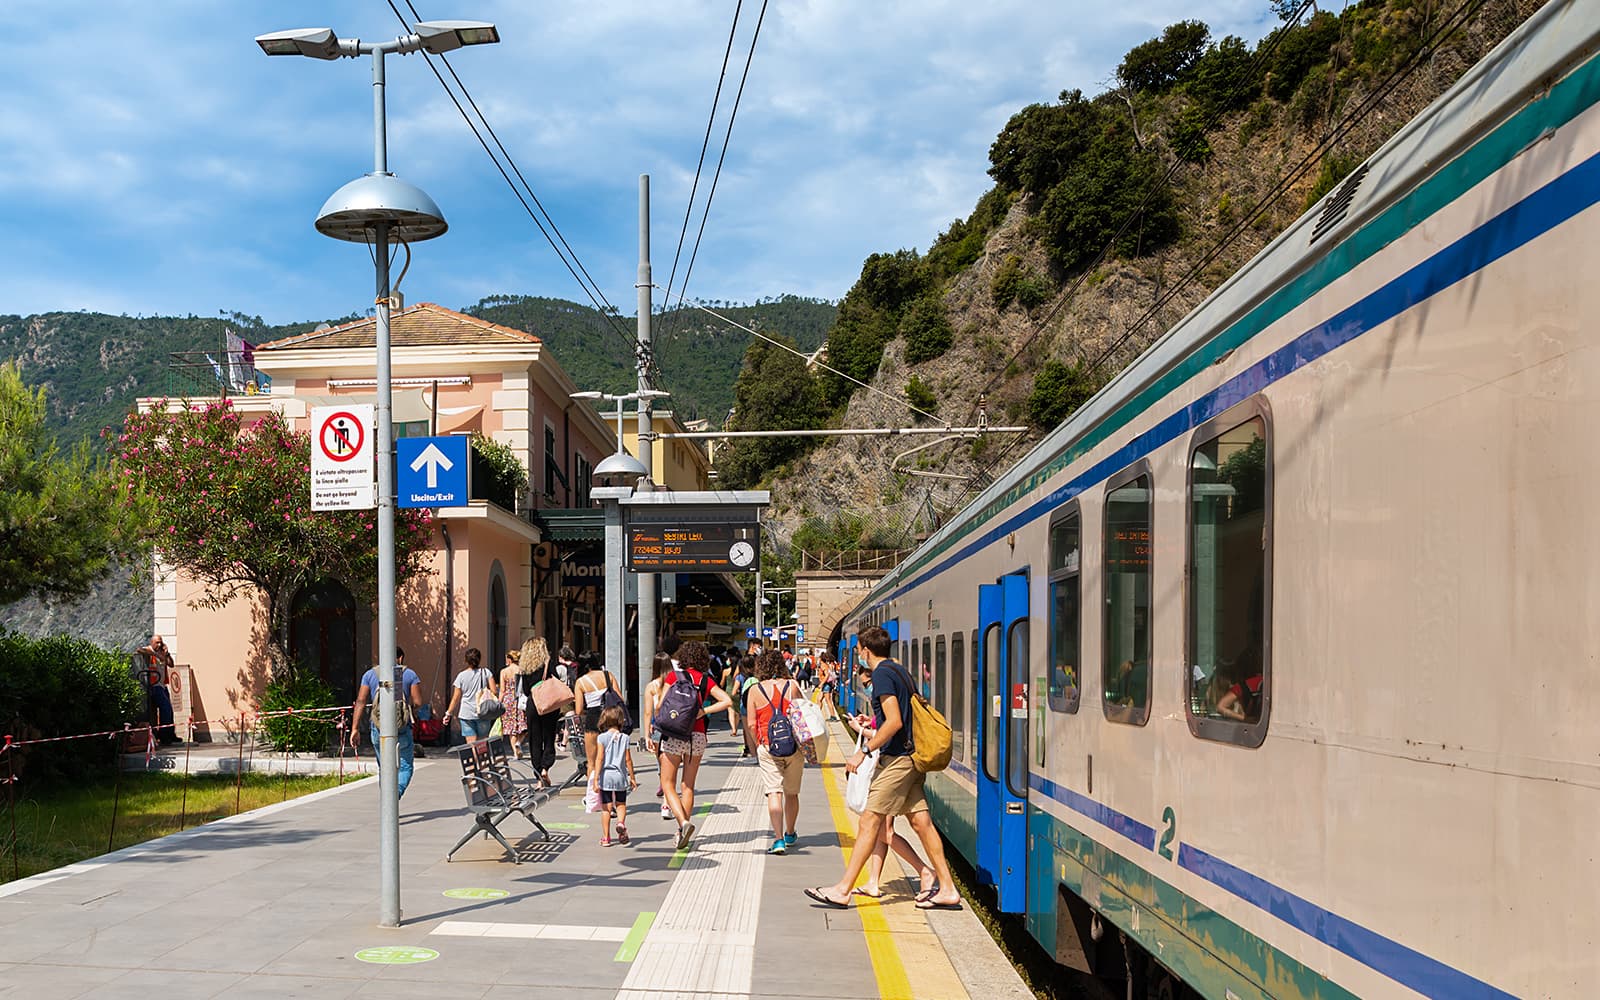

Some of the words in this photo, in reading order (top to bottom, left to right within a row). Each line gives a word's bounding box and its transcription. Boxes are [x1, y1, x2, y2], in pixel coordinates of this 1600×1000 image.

[339, 490, 358, 498] beyond
[411, 493, 454, 502] Uscita/Exit
[1158, 806, 1176, 862] 2
